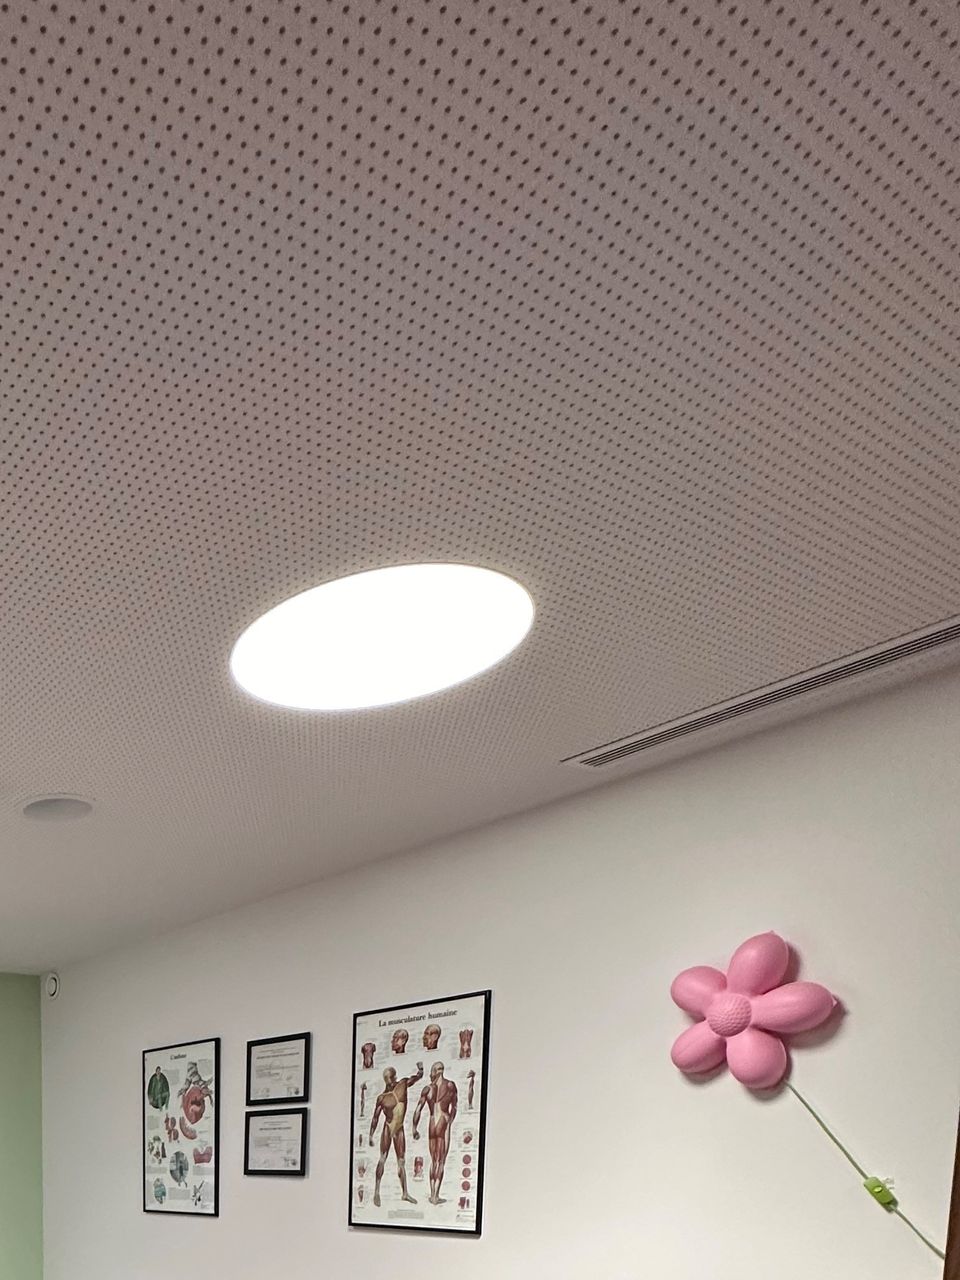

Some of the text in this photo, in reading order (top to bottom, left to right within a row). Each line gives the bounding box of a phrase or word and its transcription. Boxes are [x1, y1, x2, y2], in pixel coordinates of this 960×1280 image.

[378, 1009, 458, 1027] La musculature humaine
